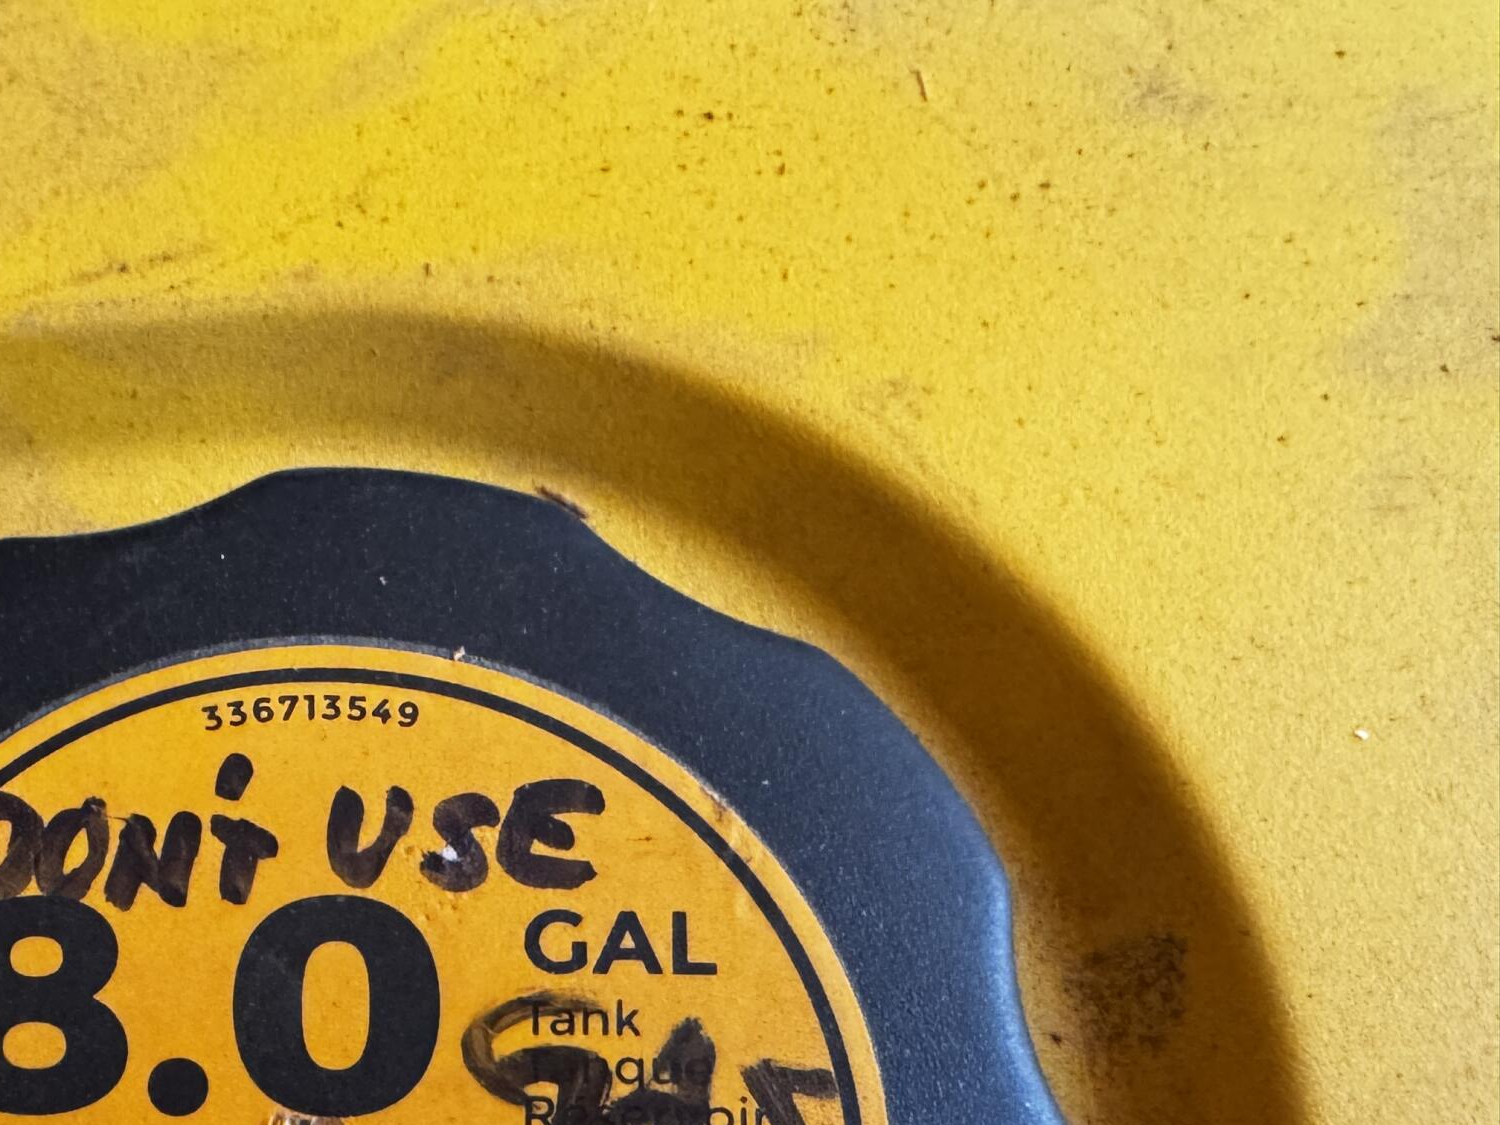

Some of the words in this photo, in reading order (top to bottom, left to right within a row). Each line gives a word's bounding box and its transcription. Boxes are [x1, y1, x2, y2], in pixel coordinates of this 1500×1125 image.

[203, 694, 419, 731] 336713549
[326, 778, 606, 893] USE
[524, 909, 718, 975] GAL
[531, 995, 641, 1036] Tank
